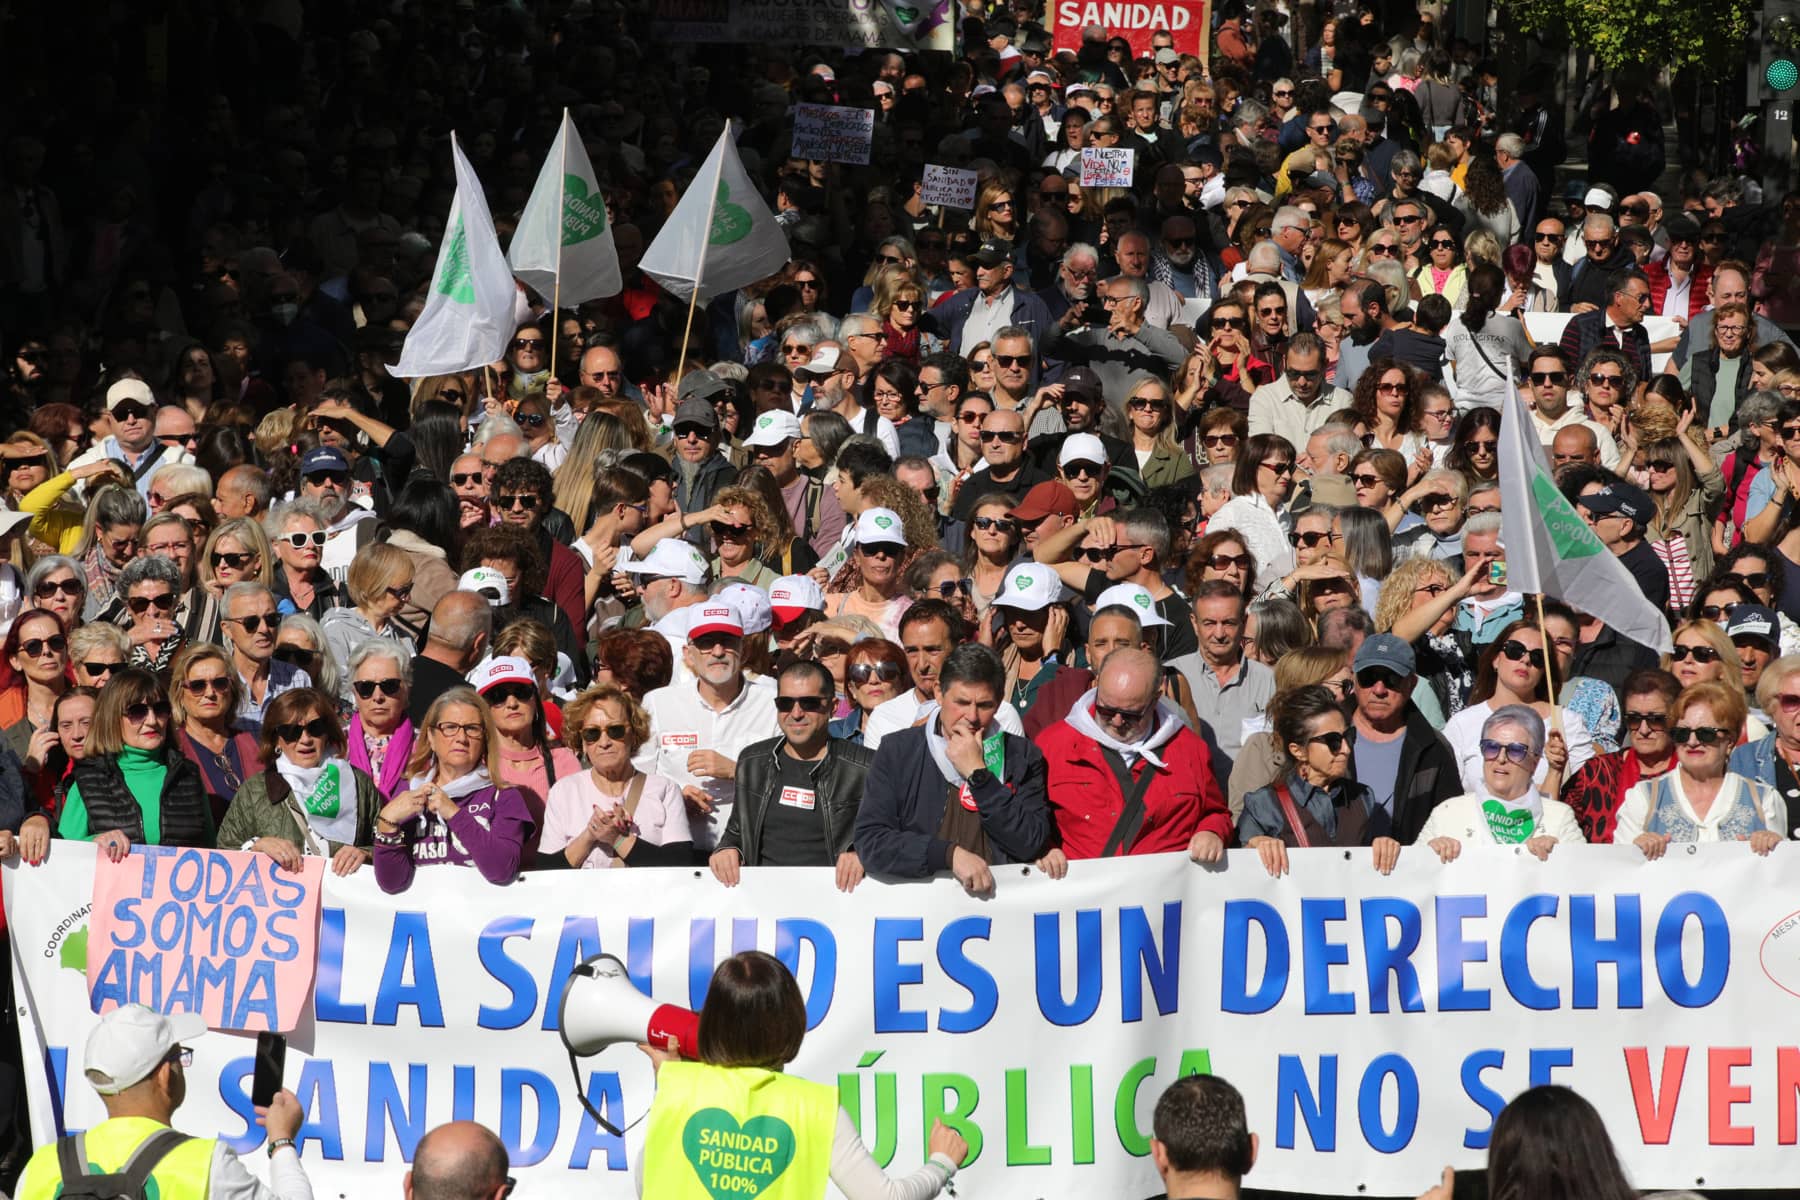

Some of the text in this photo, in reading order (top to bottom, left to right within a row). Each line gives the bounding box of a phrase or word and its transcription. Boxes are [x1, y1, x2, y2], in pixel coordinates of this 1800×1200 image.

[1059, 1, 1190, 31] SANIDAD
[838, 31, 886, 43] MAMA
[1774, 109, 1788, 120] 12
[943, 167, 959, 175] SIN
[1082, 158, 1105, 169] VIDA
[927, 173, 966, 187] SANIDAD
[1453, 333, 1505, 343] ECOLGISTAS
[664, 736, 689, 744] CCOO
[784, 791, 809, 801] CCO
[129, 844, 306, 908] TODAS
[110, 898, 299, 962] SOMOS
[1772, 919, 1798, 940] MESA
[315, 906, 445, 1029] LA
[873, 915, 999, 1034] ES
[1034, 900, 1183, 1027] UN
[1220, 890, 1732, 1016] DERECHO
[90, 949, 278, 1032] AMAMA
[218, 1055, 628, 1172] SANIDA
[837, 1048, 1214, 1171] ÚBLIC
[1275, 1051, 1421, 1155] NO
[699, 1127, 779, 1154] SANIDAD
[698, 1147, 774, 1175] PÚBLICA
[710, 1172, 758, 1195] 100%
